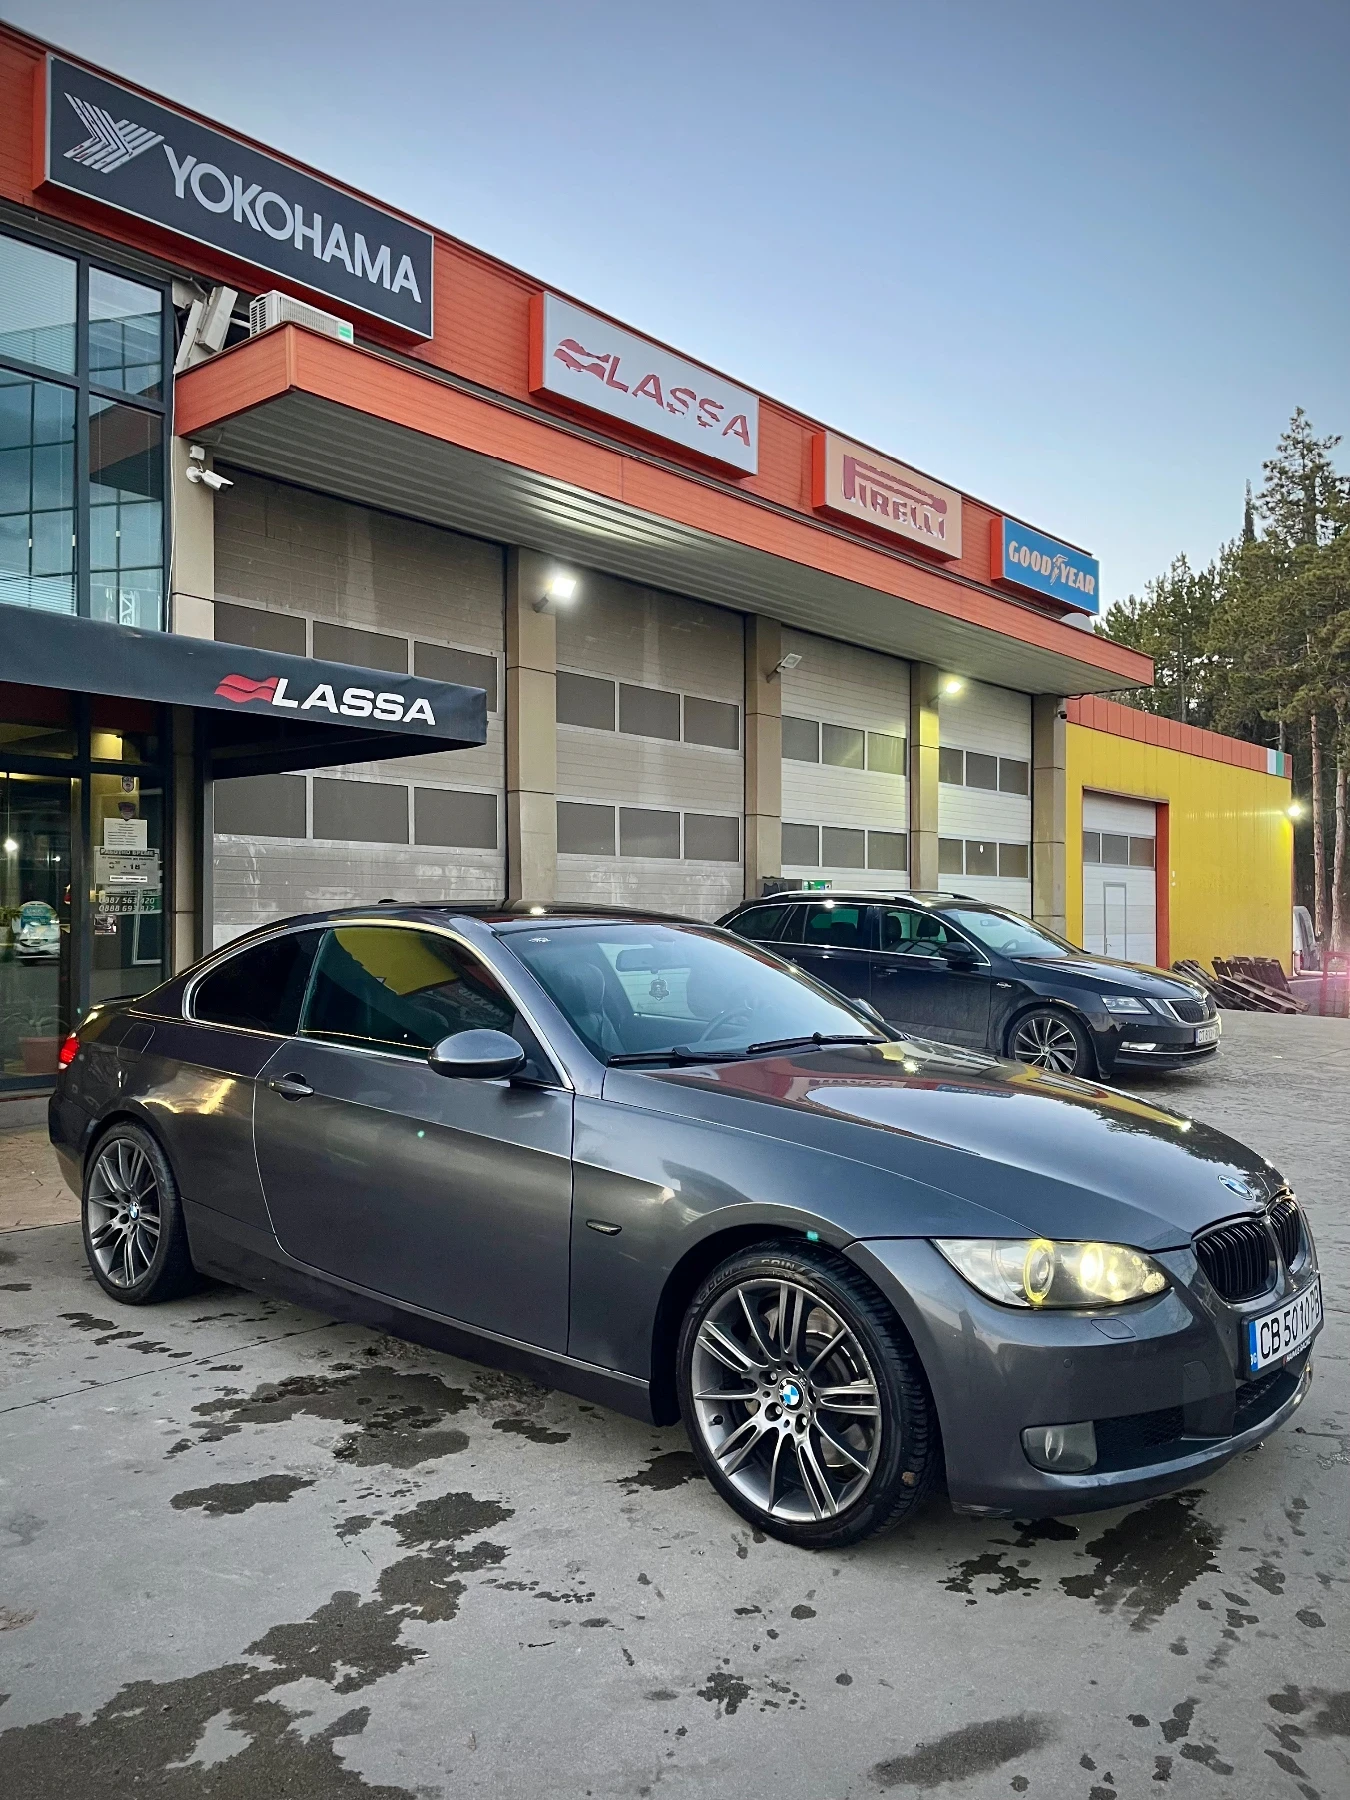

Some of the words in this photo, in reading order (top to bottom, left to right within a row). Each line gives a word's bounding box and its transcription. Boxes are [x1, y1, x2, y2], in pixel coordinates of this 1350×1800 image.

[163, 144, 422, 303] YOKOHAMA
[606, 356, 750, 447] LASSA
[842, 454, 947, 540] PIRELLI
[271, 678, 436, 725] LASSA
[1260, 1317, 1281, 1360] CB
[1284, 1296, 1310, 1347] 5010
